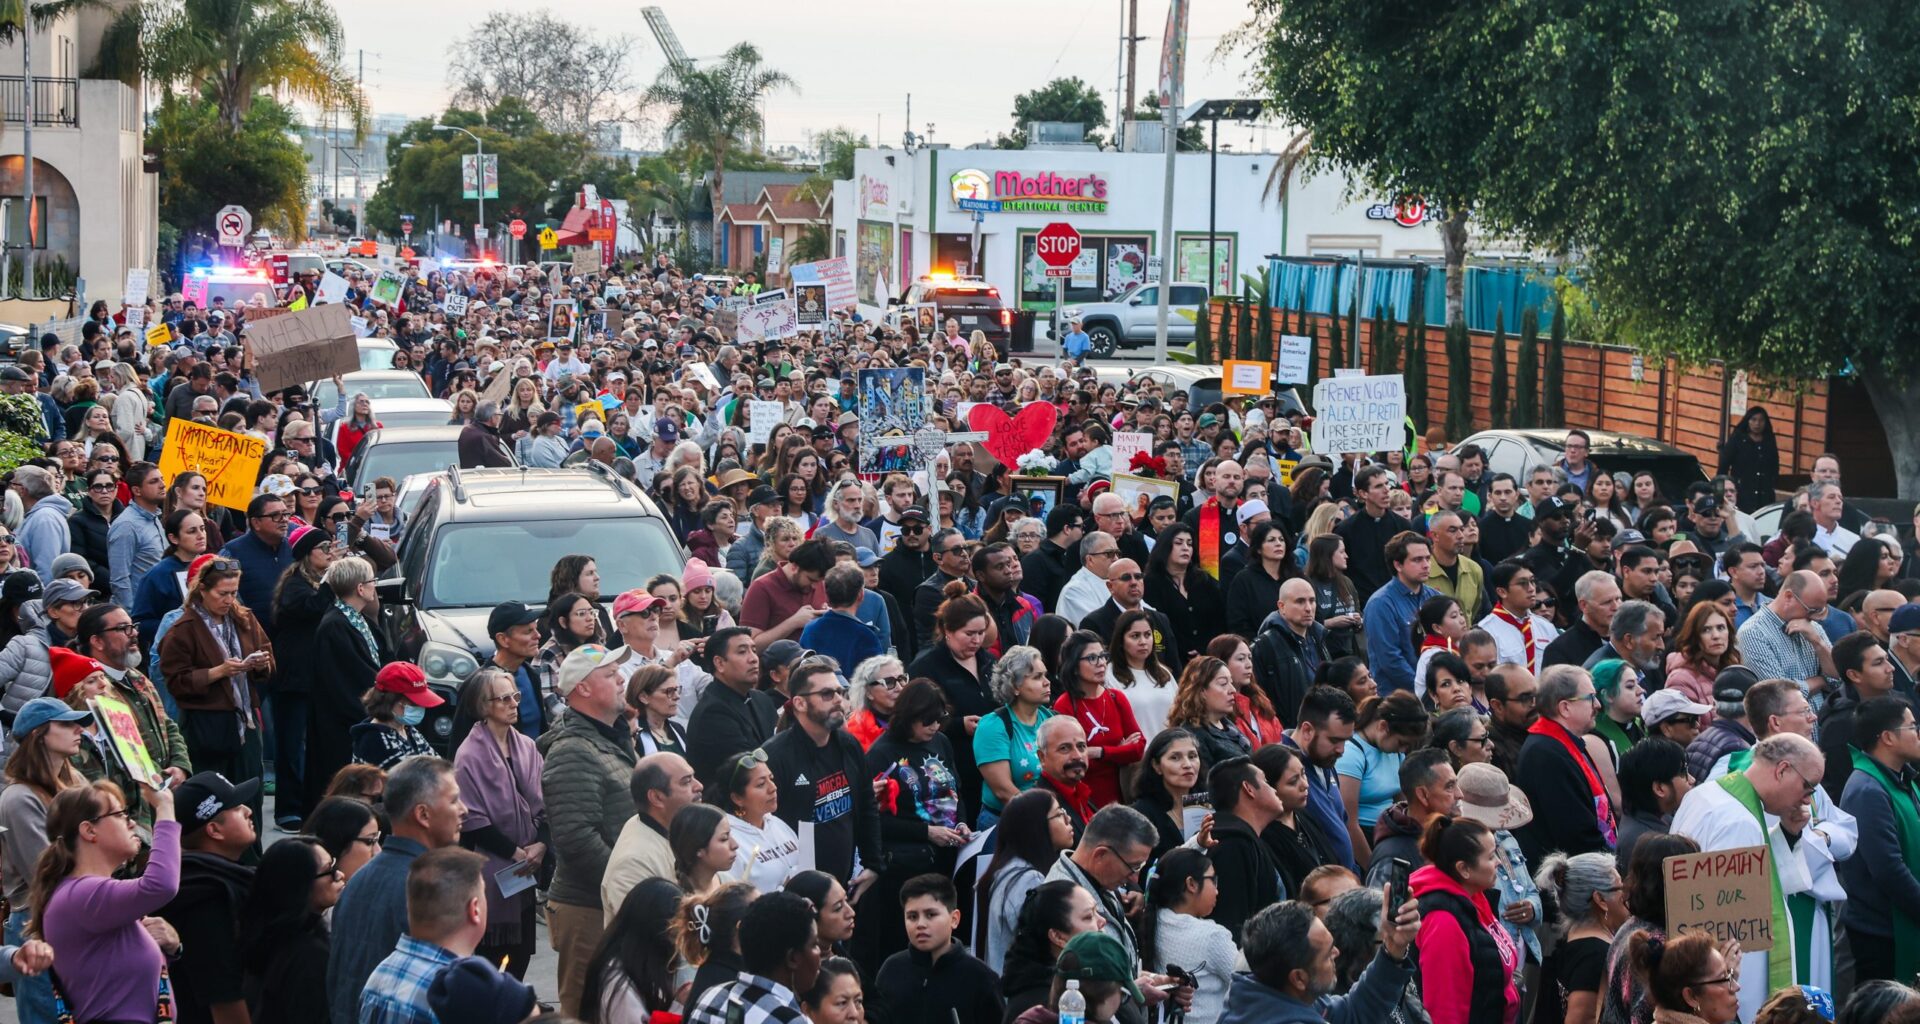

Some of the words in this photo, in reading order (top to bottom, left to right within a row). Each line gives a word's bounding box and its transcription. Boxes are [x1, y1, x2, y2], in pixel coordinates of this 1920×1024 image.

[995, 170, 1107, 199] Mother's
[962, 201, 989, 210] NATIONAL
[1003, 202, 1062, 212] UTRITIONAL
[1067, 202, 1107, 212] CENTER
[1039, 236, 1078, 253] STOP
[449, 296, 465, 305] ICE
[755, 308, 779, 319] ASK
[247, 315, 318, 353] WHEN
[765, 327, 778, 337] DUE
[1328, 382, 1362, 402] RENEE
[1373, 381, 1397, 399] GOOD
[1328, 405, 1357, 422] ALEX
[995, 418, 1028, 433] LOVE
[1001, 432, 1025, 445] LIKE
[1329, 437, 1381, 452] PRESENT
[177, 447, 195, 462] The
[197, 451, 228, 466] Heart
[826, 789, 843, 802] NEEDS
[1672, 849, 1765, 881] EMPATHY
[1691, 894, 1704, 911] IS
[1716, 889, 1746, 906] OUR
